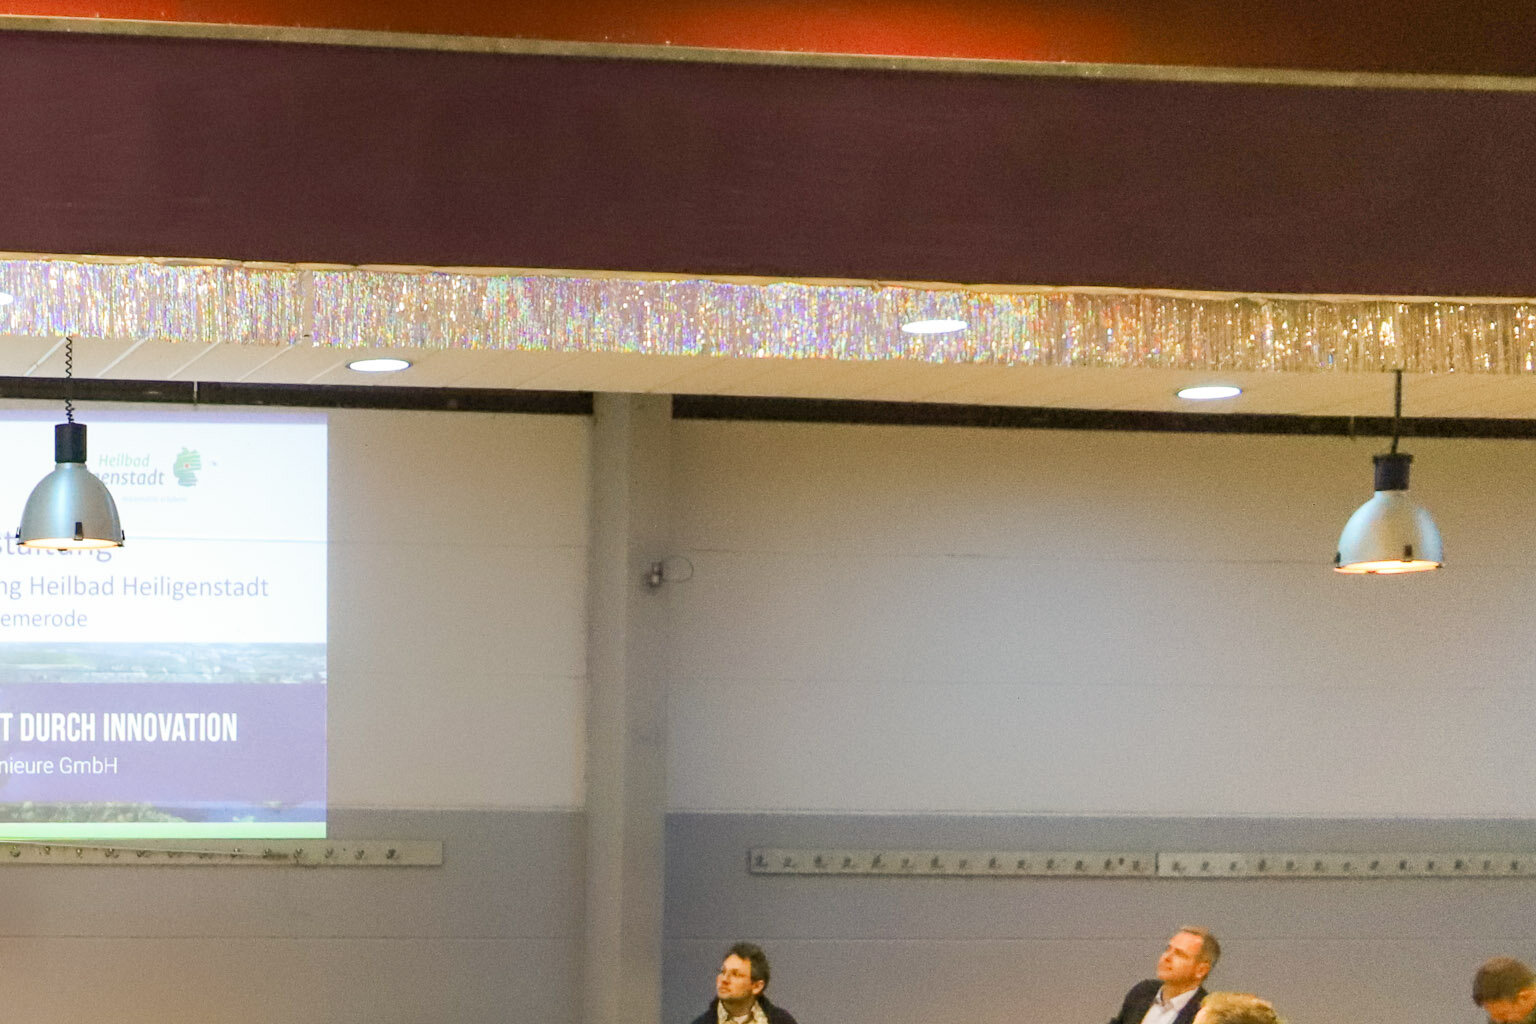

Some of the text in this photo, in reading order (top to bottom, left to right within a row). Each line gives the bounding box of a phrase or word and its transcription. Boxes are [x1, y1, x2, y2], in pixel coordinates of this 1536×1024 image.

[98, 453, 151, 468] Heilbad
[95, 469, 165, 485] enstadt
[30, 576, 114, 596] Heilbad
[123, 576, 270, 601] Heiligenstadt
[20, 712, 96, 742] DURCH
[103, 712, 238, 742] INNOVATION
[59, 757, 118, 775] GmbH
